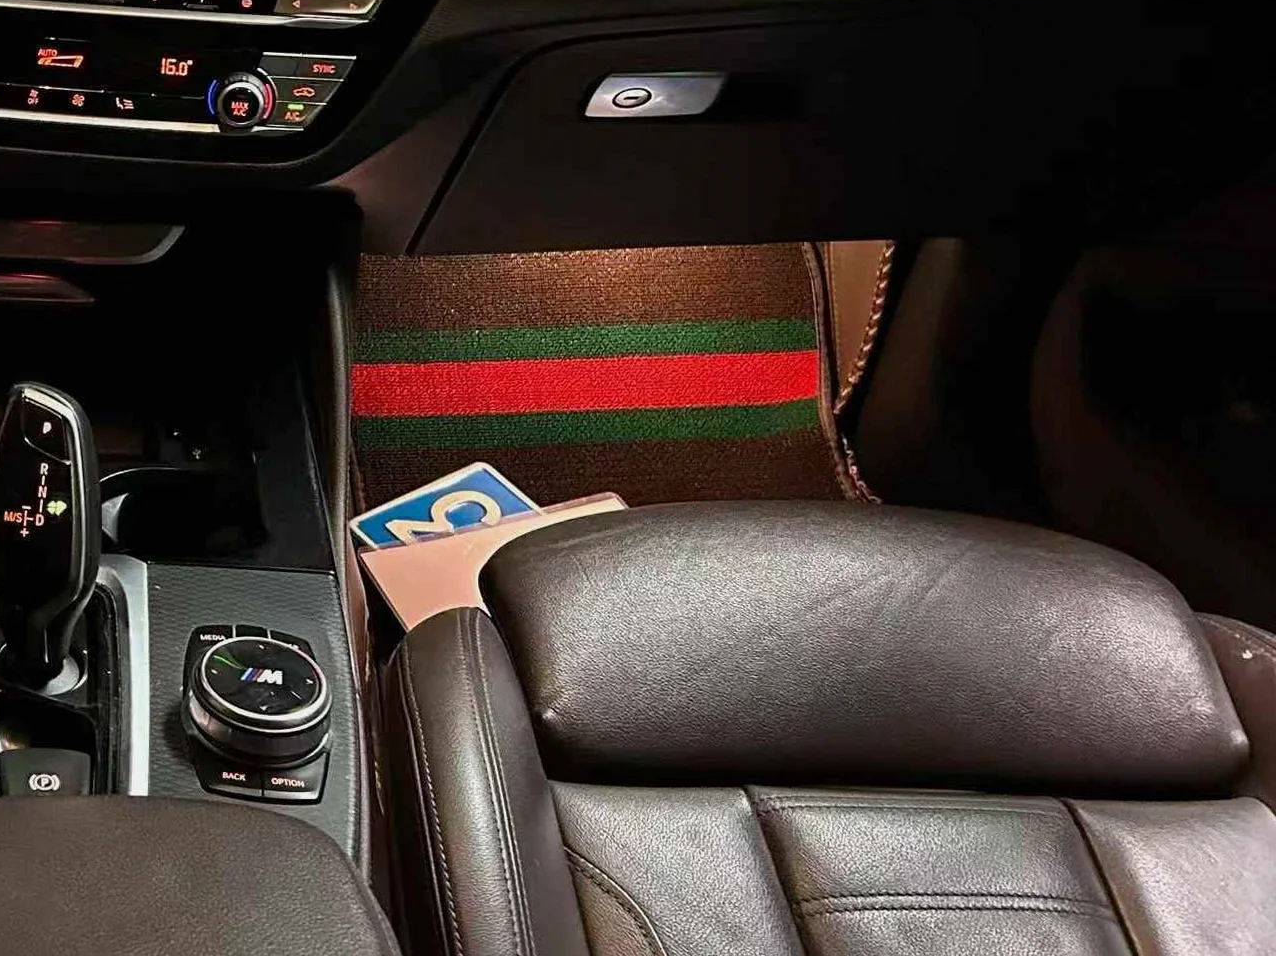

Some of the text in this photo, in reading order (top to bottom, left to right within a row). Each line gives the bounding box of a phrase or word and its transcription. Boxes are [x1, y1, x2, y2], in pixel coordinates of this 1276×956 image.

[37, 48, 58, 57] AUTO
[312, 64, 336, 74] SYNC
[27, 97, 39, 106] OFF
[231, 101, 249, 110] MAX
[233, 108, 246, 117] A/C
[284, 111, 301, 121] A/C
[42, 421, 52, 434] P
[40, 463, 49, 475] R
[37, 485, 48, 498] N
[4, 510, 45, 526] M/S D
[222, 771, 246, 782] BACK
[271, 777, 305, 789] OPTION
